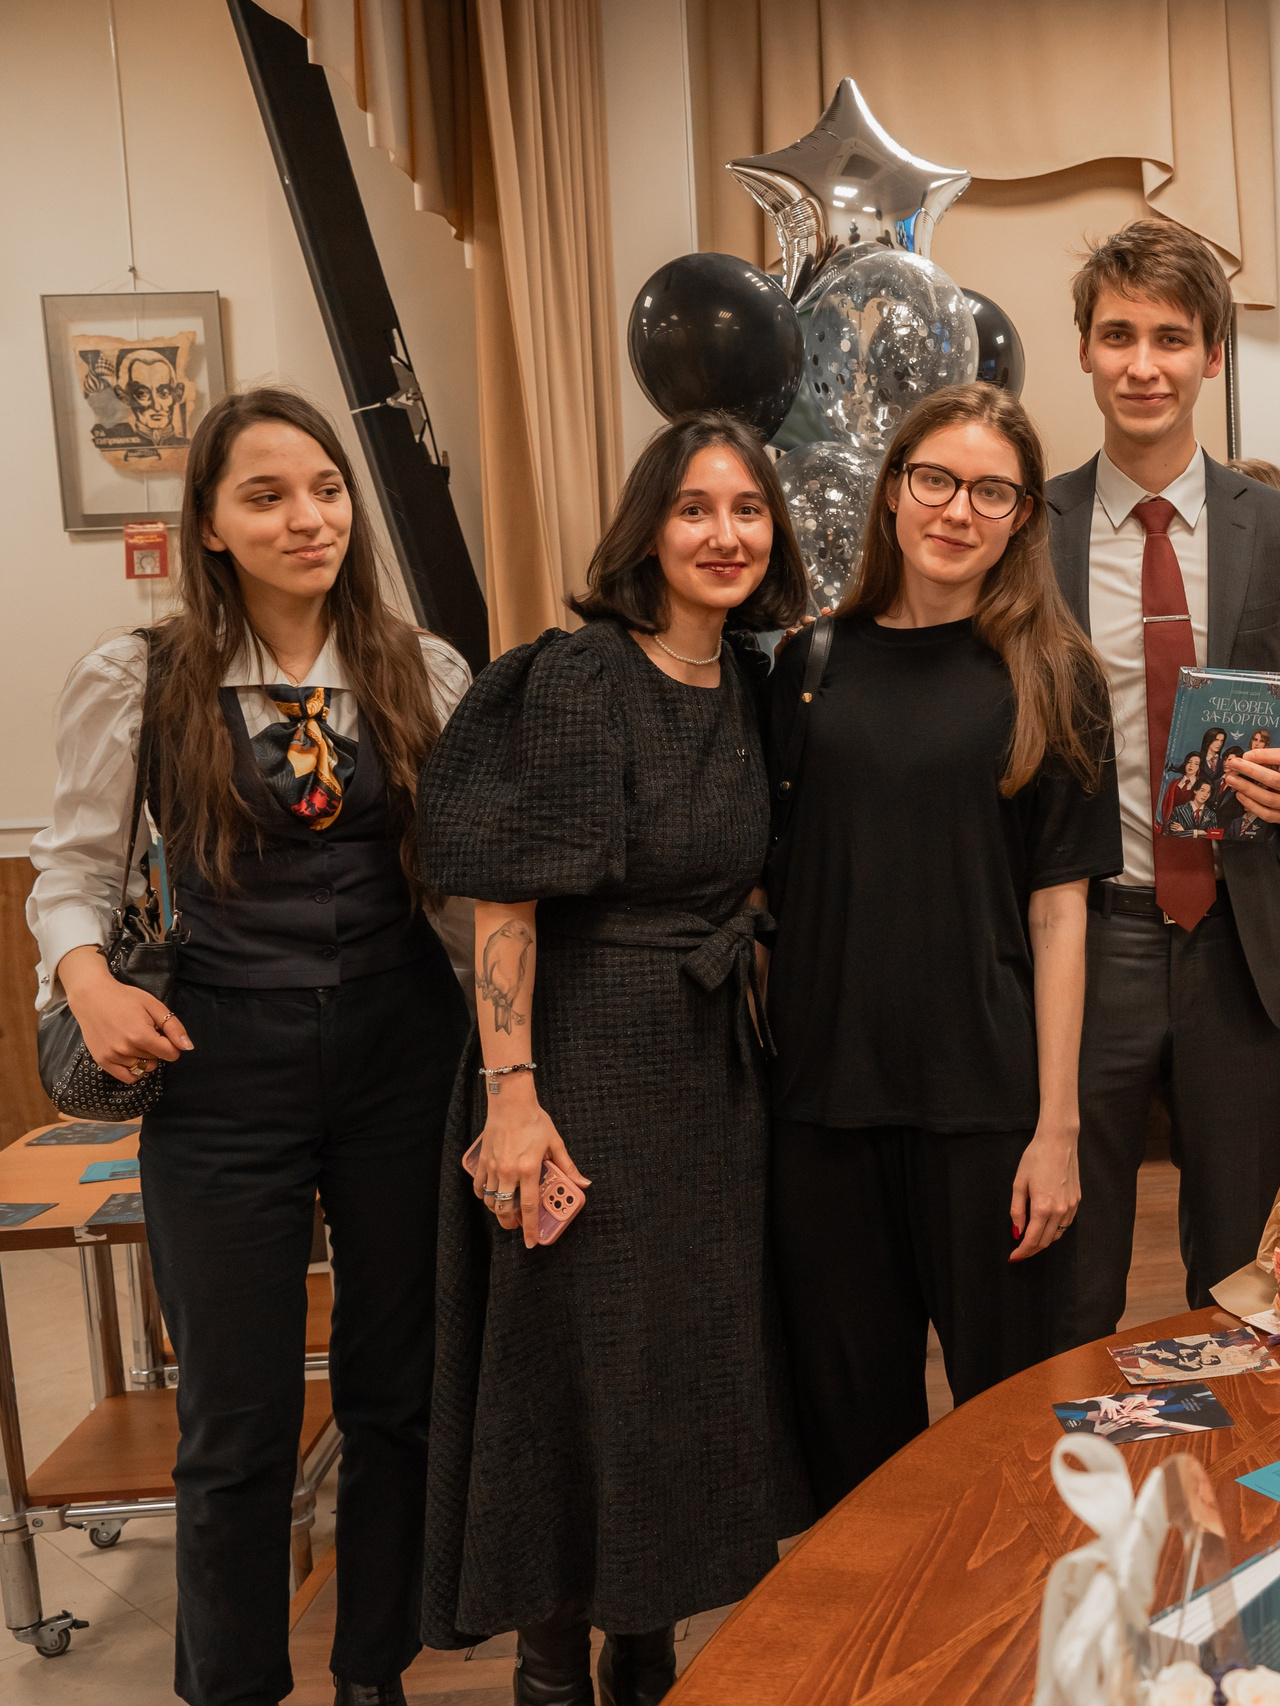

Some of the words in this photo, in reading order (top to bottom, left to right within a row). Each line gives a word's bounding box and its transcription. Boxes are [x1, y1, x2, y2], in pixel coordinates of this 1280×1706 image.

[1208, 696, 1276, 715] ЧЕЛОВЕК
[1201, 709, 1221, 723] ЗА
[1221, 711, 1280, 728] БОРТОМ
